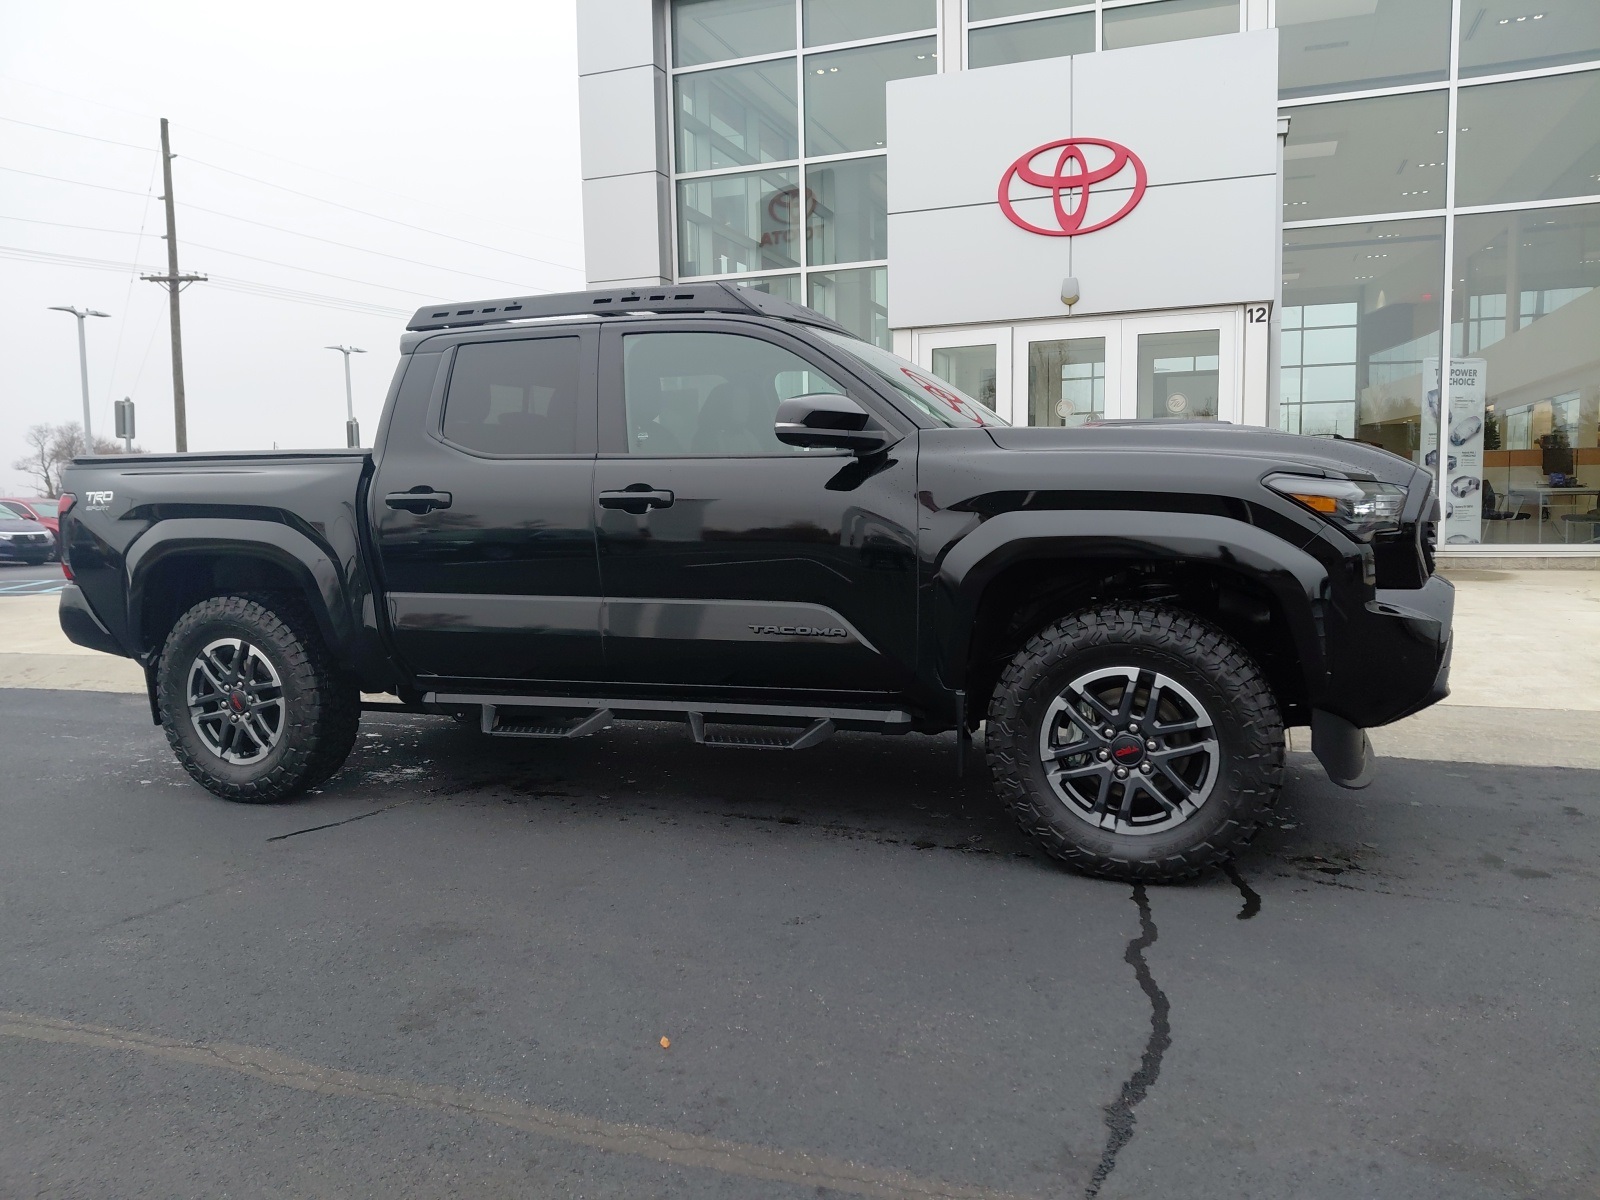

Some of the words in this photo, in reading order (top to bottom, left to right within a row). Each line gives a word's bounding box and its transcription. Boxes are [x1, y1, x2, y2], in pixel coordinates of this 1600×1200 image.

[1247, 307, 1267, 323] 12
[1450, 369, 1478, 377] POWER
[85, 490, 114, 504] TRD
[748, 624, 848, 637] TACOMA
